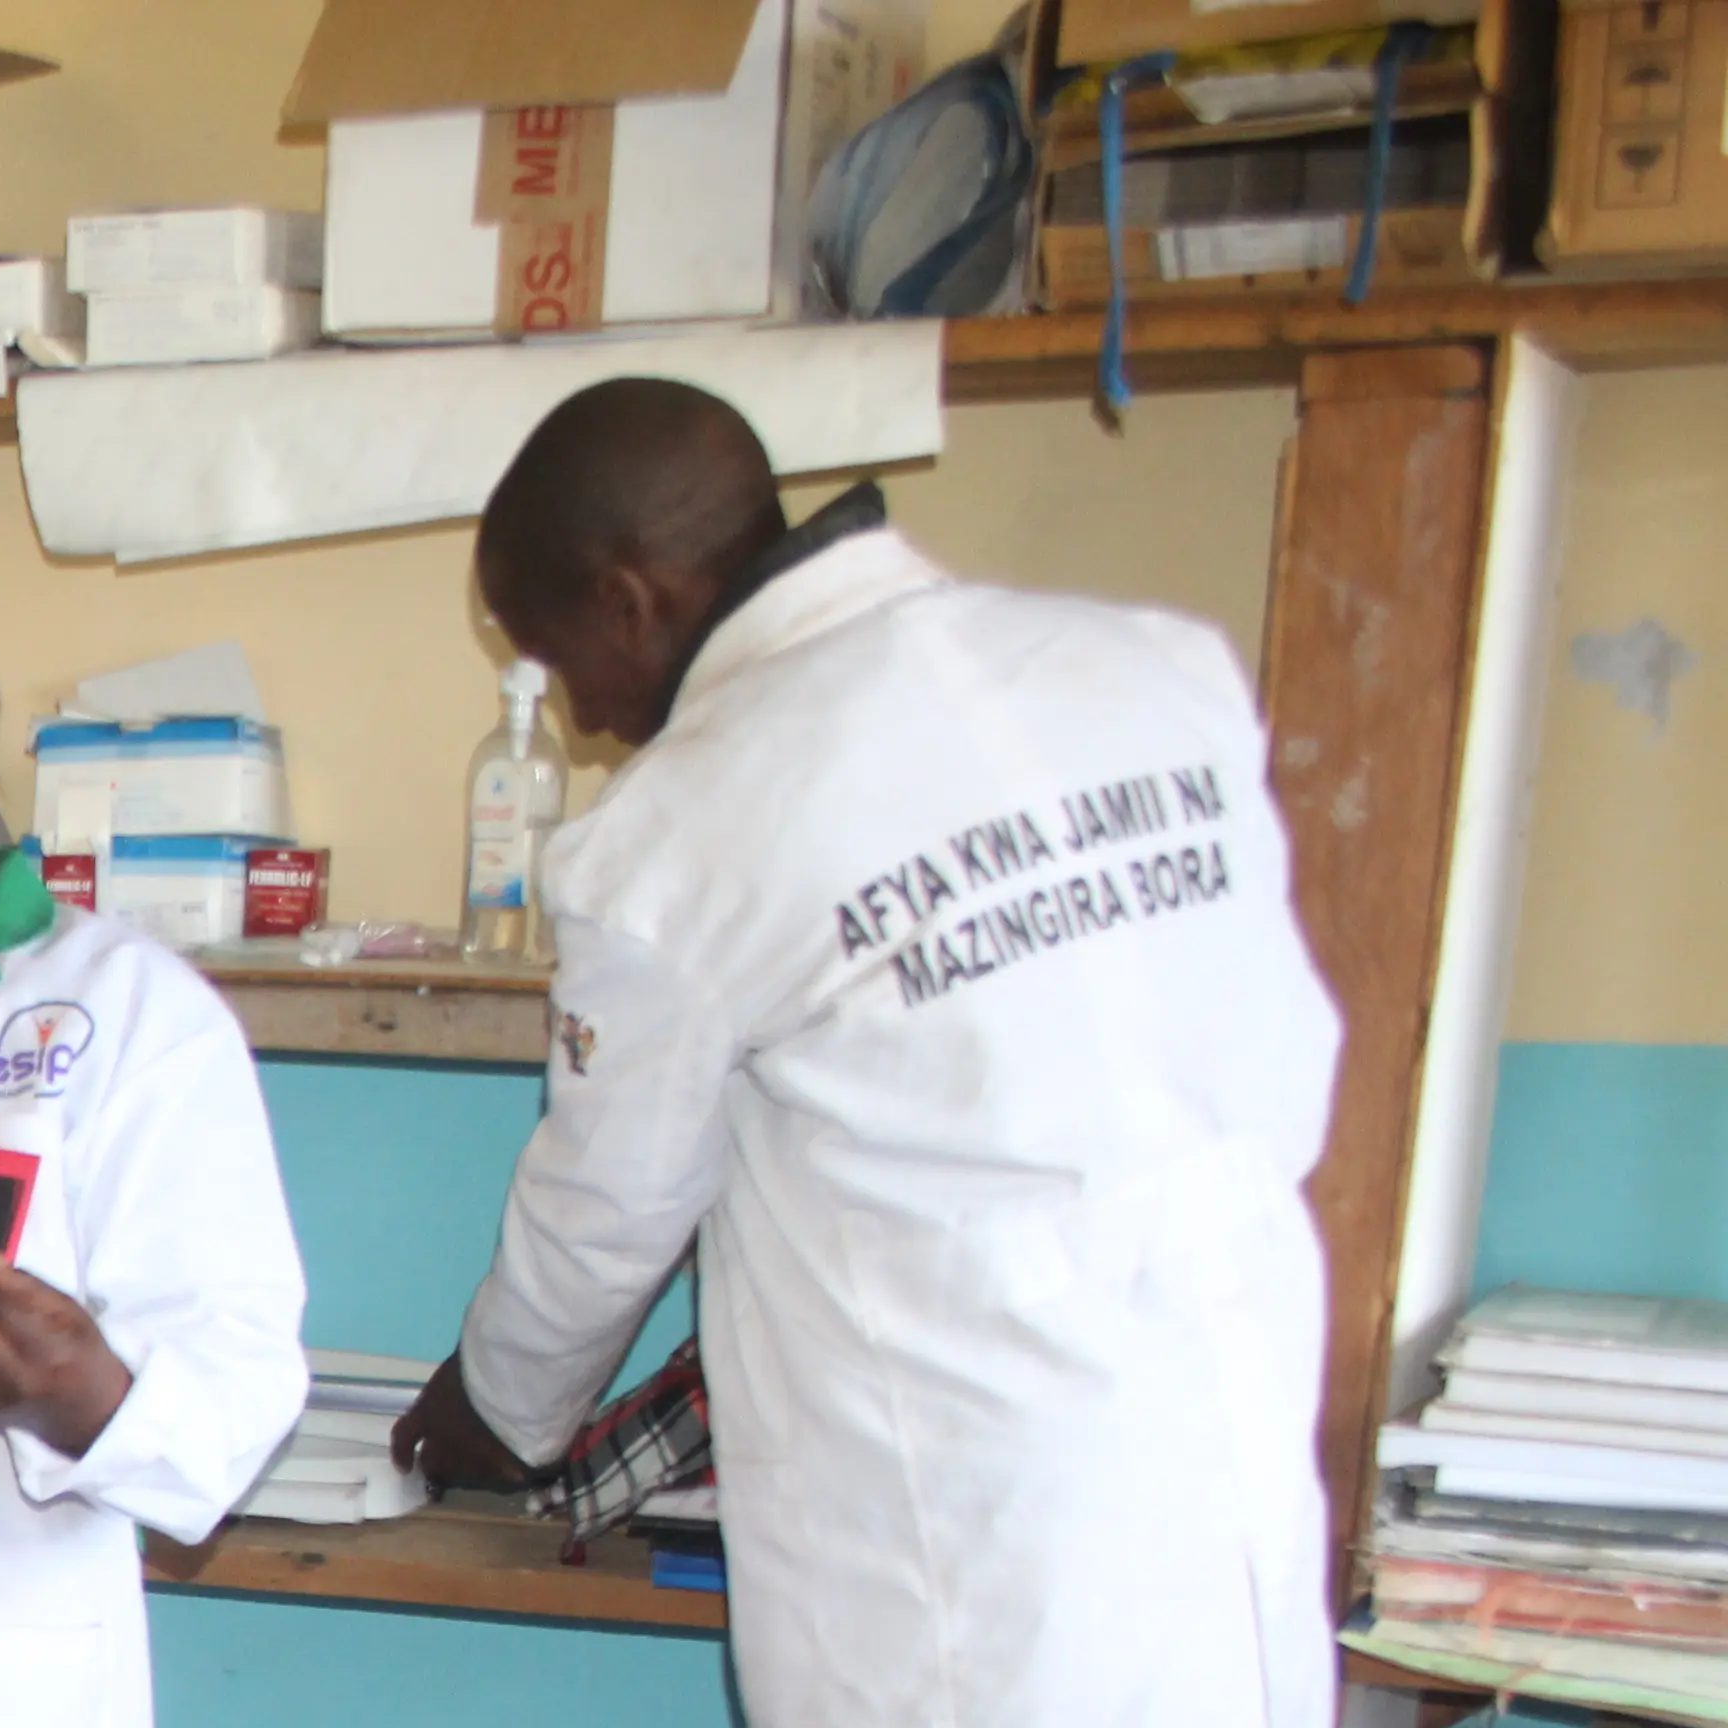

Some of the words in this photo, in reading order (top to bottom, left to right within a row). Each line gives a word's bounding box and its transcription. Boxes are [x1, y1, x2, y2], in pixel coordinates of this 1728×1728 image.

[833, 852, 959, 962] AFYA
[945, 807, 1057, 893] KWA
[1058, 773, 1168, 855] JAMII
[888, 867, 1134, 1011] MAZINGIRA
[1126, 840, 1232, 919] BORA
